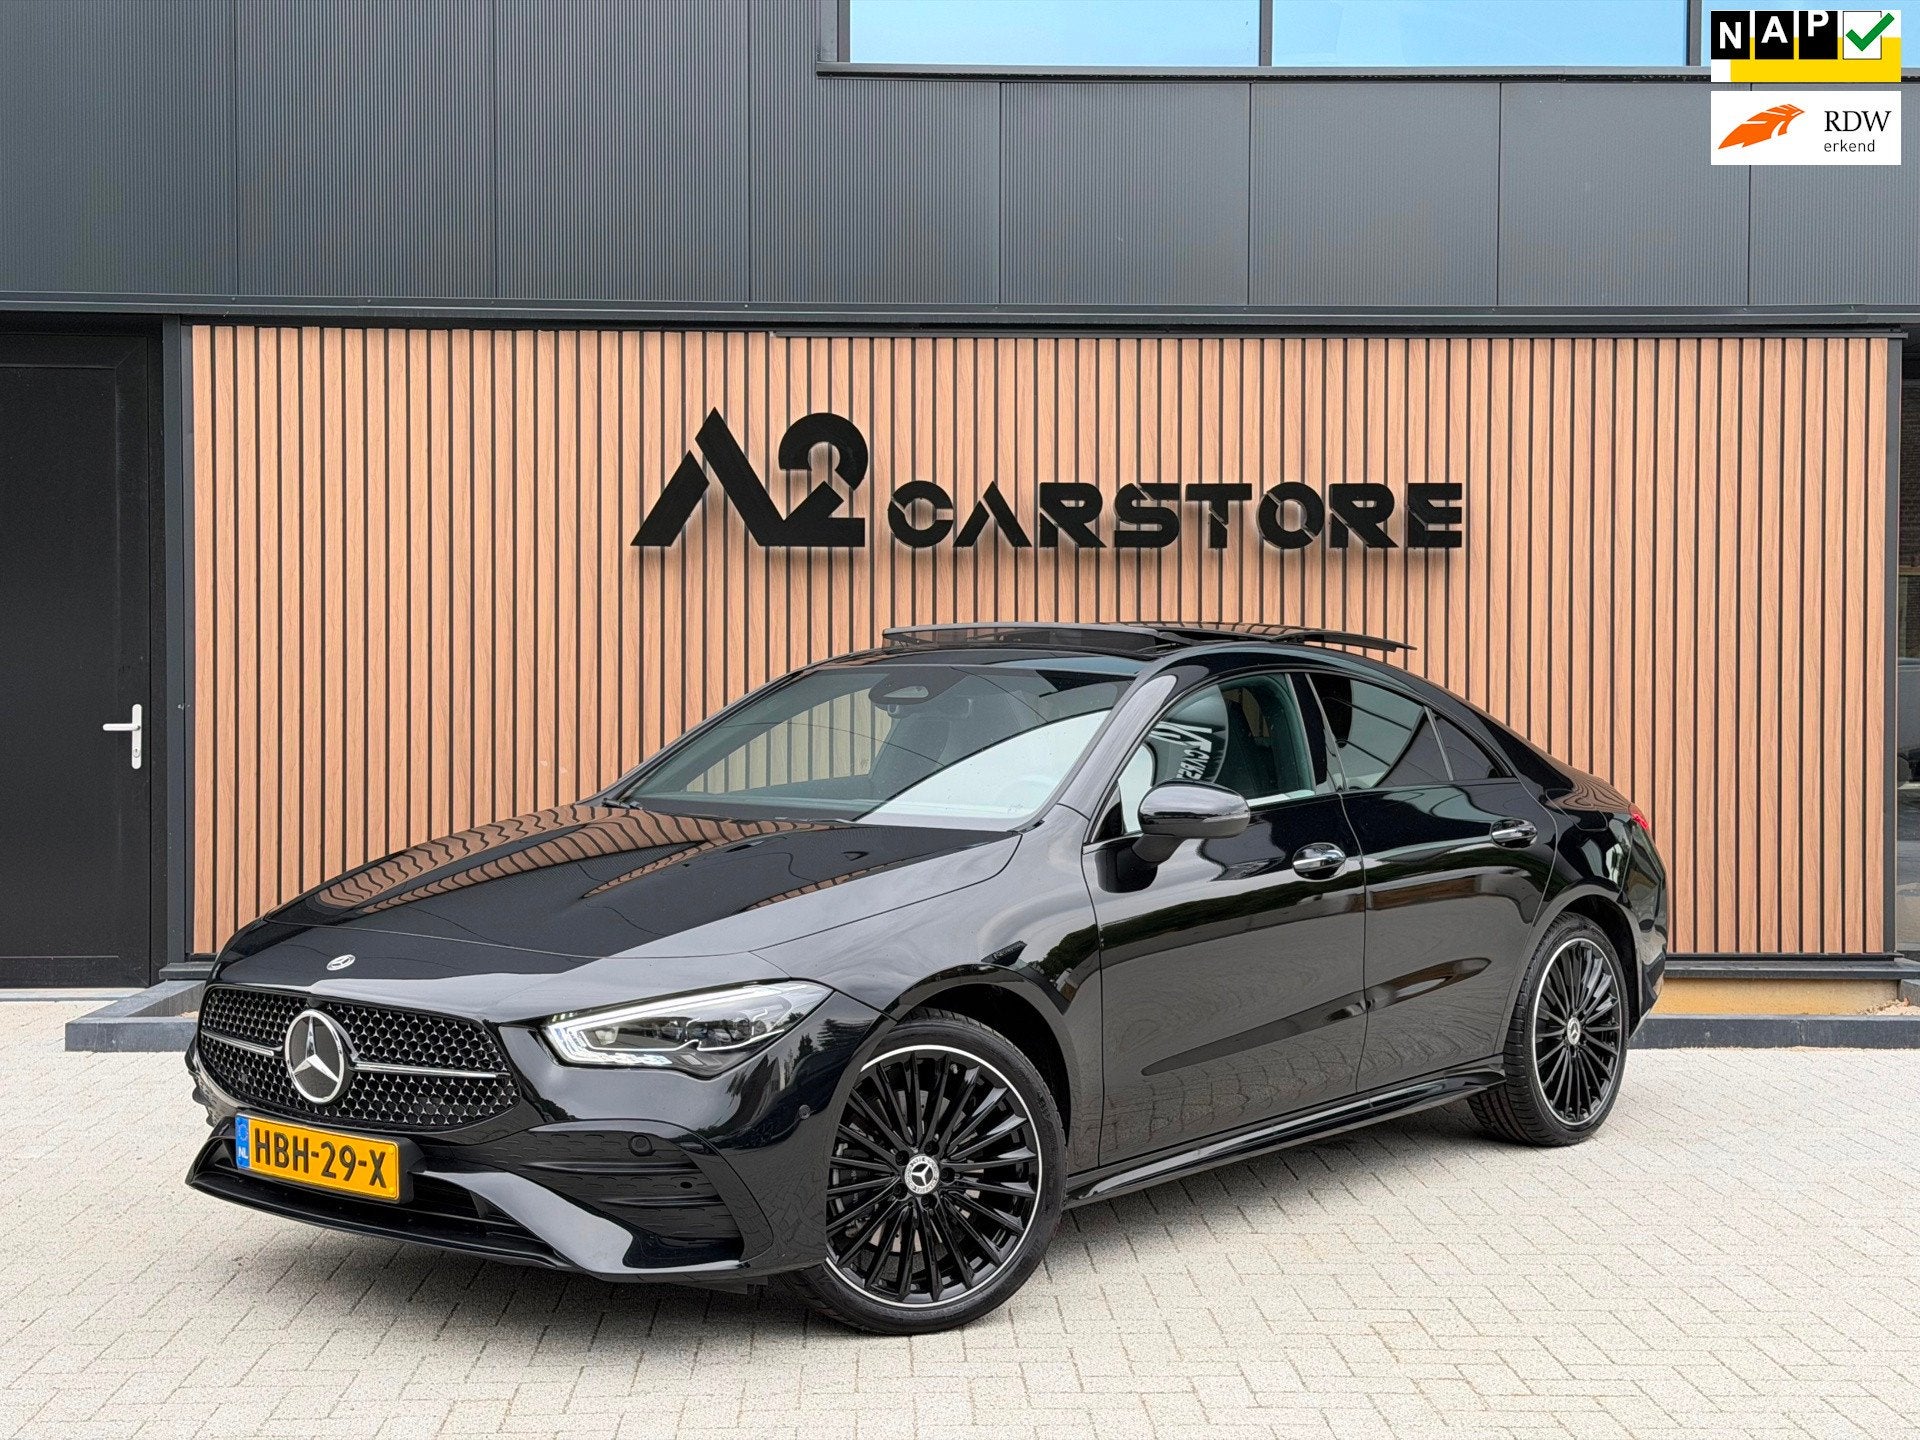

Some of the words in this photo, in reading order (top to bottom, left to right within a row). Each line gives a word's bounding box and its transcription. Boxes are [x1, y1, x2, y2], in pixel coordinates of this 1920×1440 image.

[630, 406, 869, 547] A2
[888, 481, 1463, 549] CARSTORE
[238, 1146, 249, 1160] NL
[254, 1127, 387, 1189] HBH-29-X
